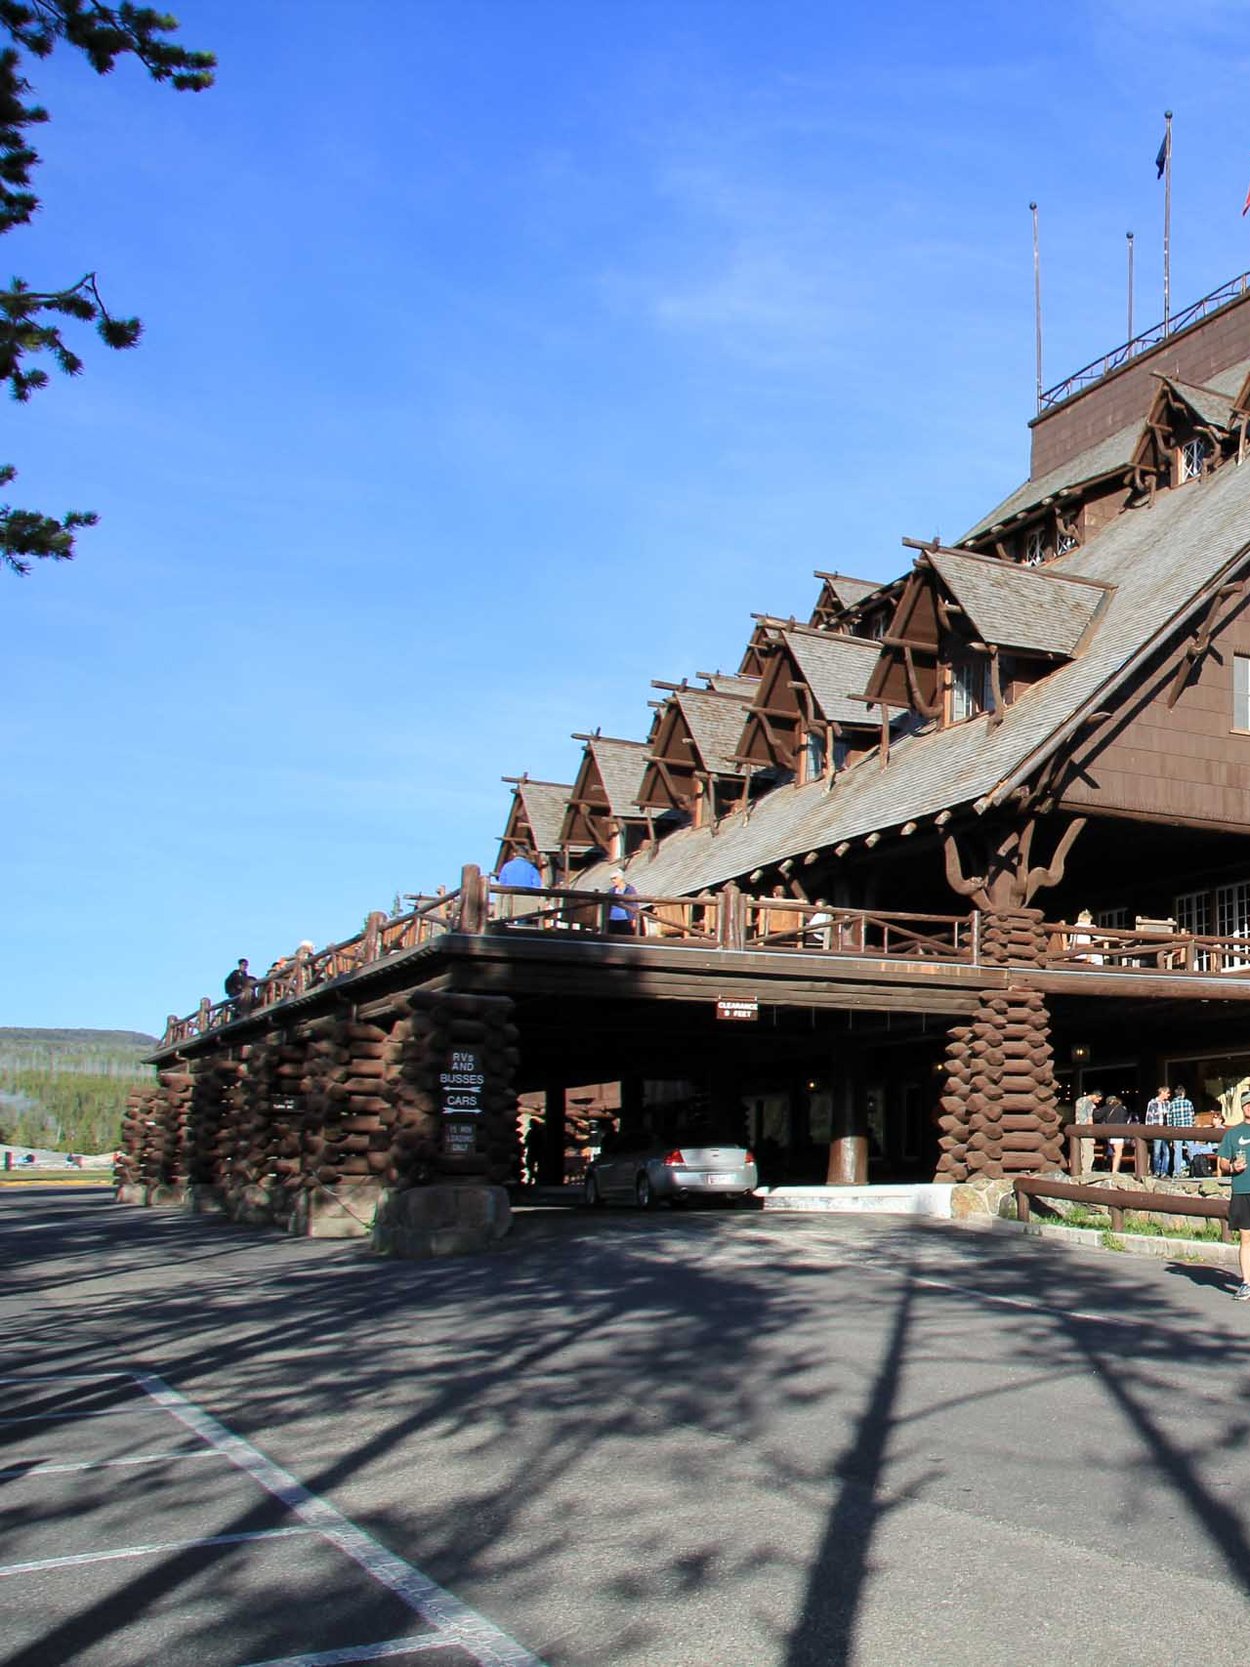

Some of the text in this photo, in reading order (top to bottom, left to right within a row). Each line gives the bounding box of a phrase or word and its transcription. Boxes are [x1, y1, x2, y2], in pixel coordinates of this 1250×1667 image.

[717, 1002, 758, 1010] CLEARANCE
[733, 1010, 752, 1018] FEET
[453, 1052, 474, 1061] RVs
[452, 1063, 474, 1071] AND
[440, 1074, 484, 1084] BUSSES
[447, 1096, 477, 1105] CARS
